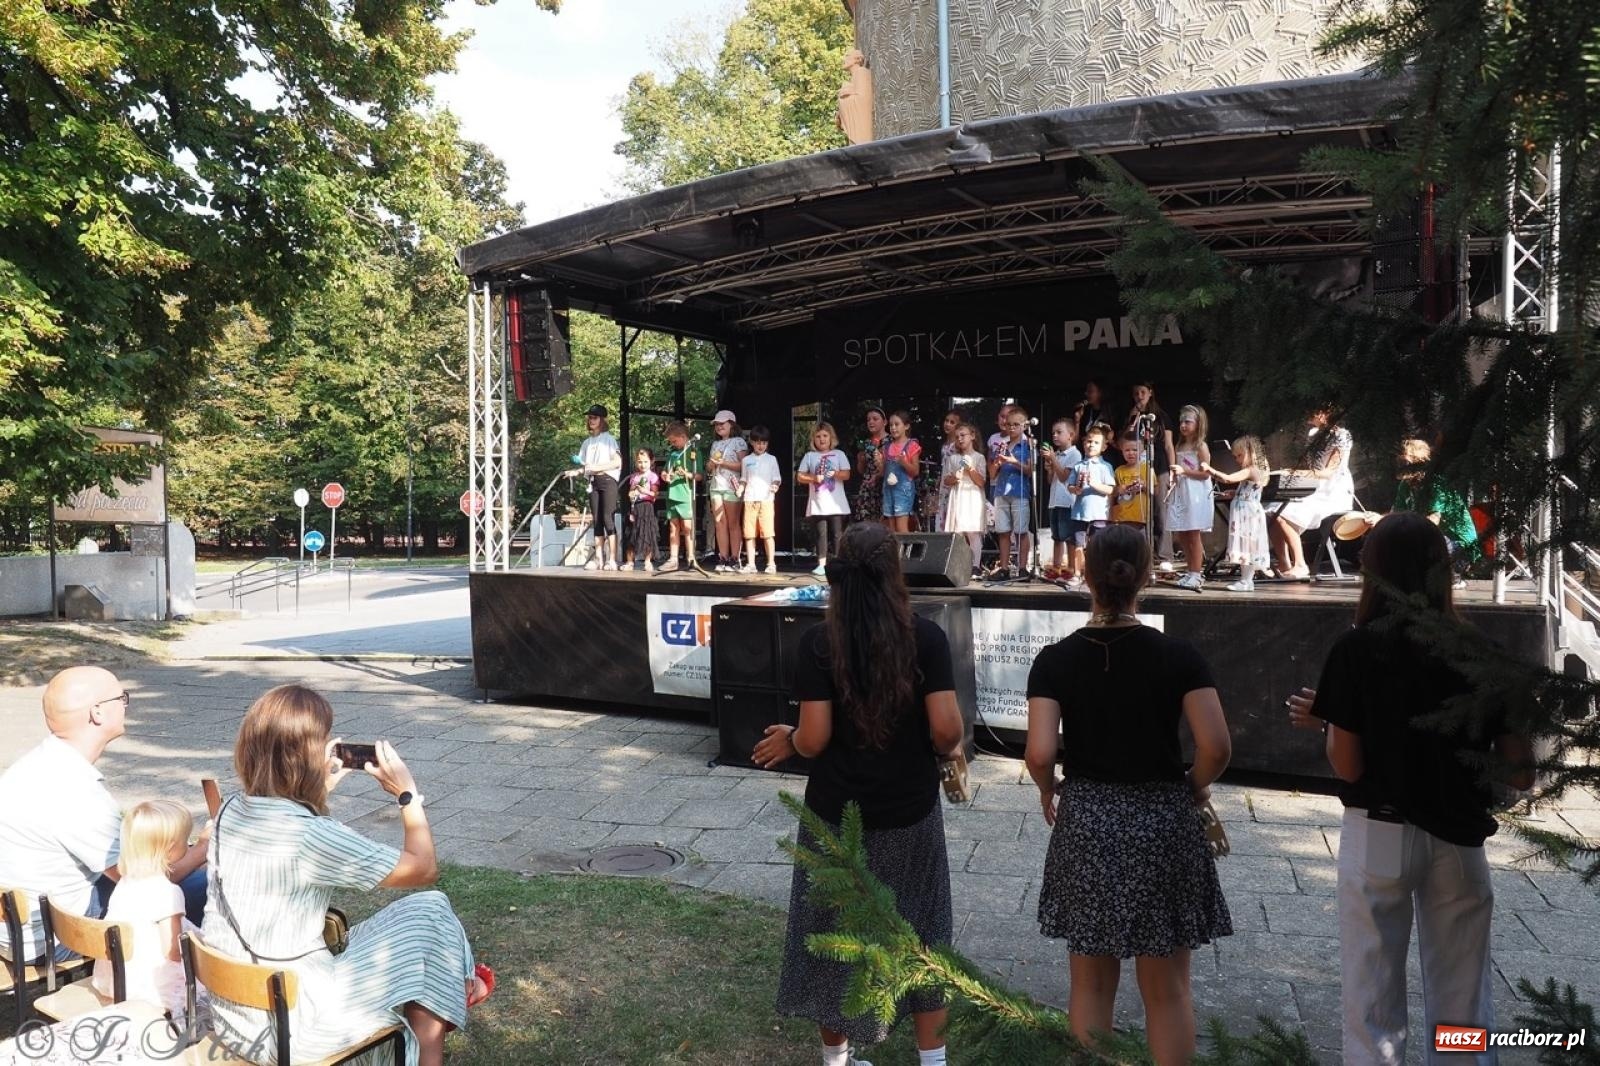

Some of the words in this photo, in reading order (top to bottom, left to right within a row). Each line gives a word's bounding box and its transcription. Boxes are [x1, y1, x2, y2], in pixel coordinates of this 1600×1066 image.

[843, 323, 1047, 368] SPOTKAŁEM
[1063, 313, 1184, 352] PANA
[324, 490, 342, 500] STOP
[667, 619, 692, 640] CZ
[993, 633, 1016, 642] UNIA
